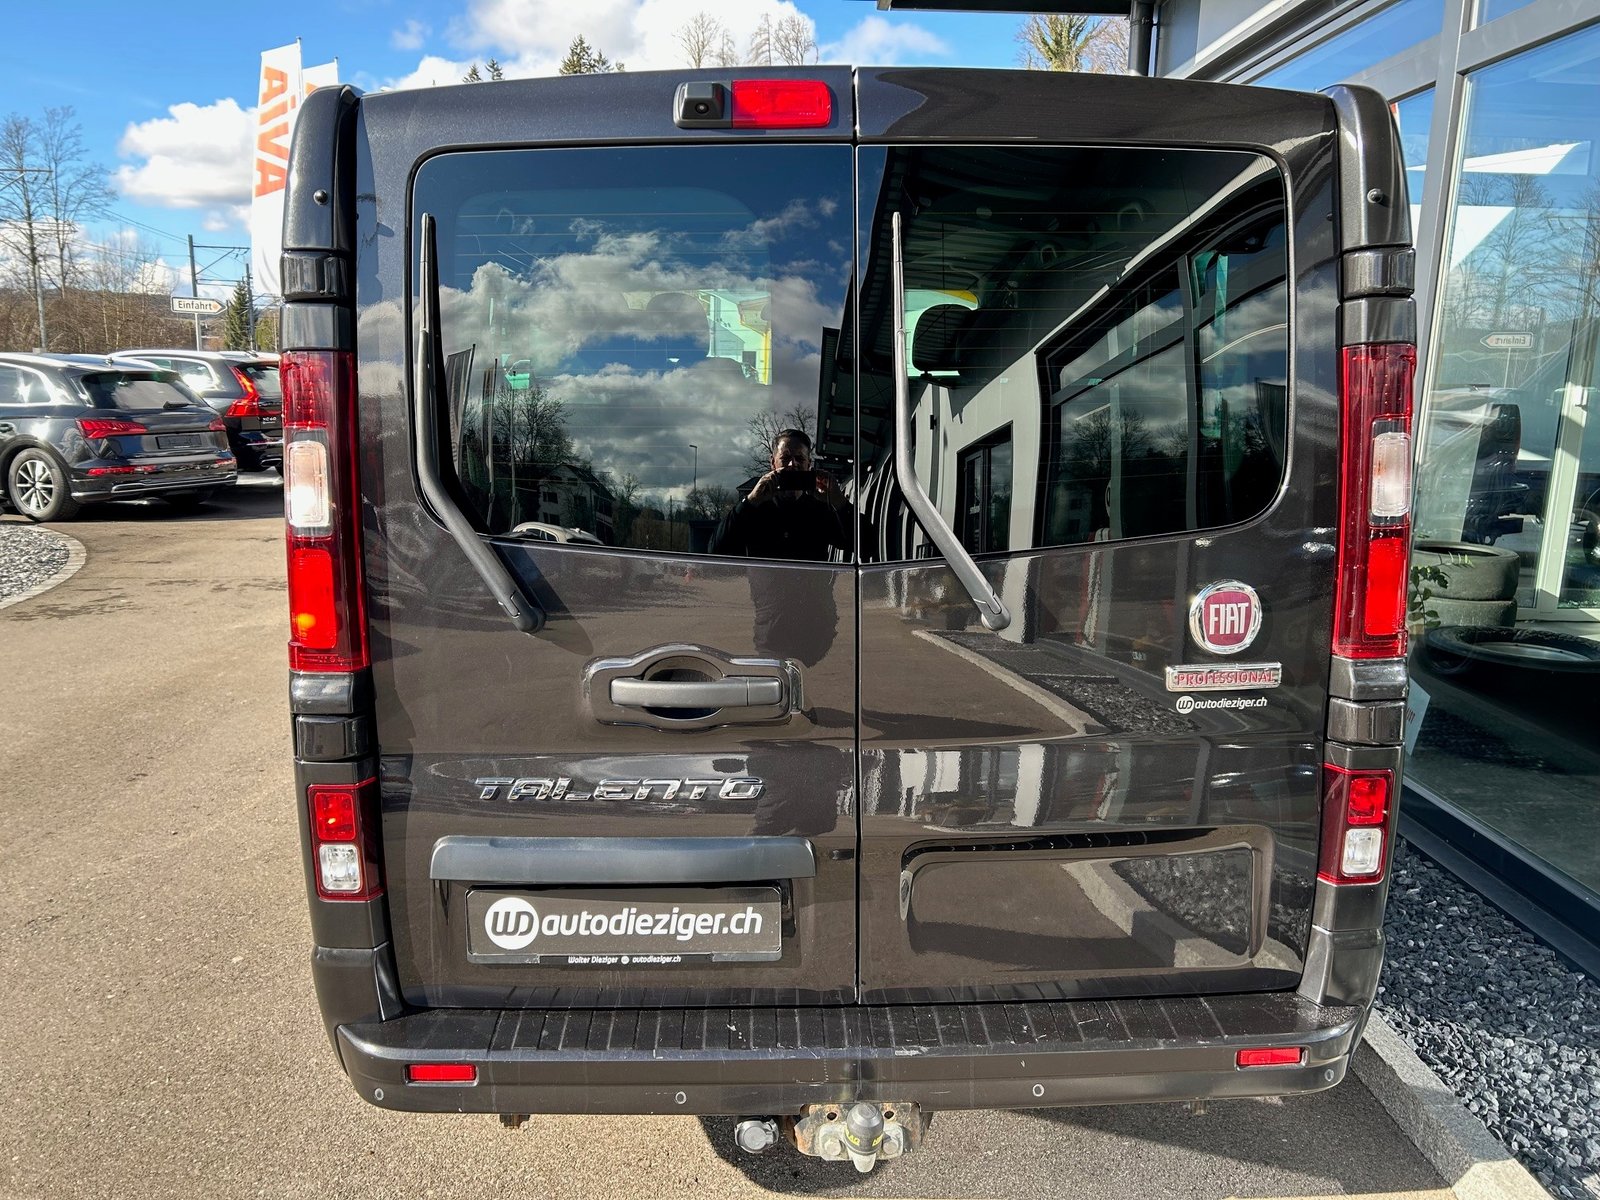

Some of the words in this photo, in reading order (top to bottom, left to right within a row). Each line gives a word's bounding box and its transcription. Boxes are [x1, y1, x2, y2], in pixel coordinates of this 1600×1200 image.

[178, 300, 212, 310] Einfahrt
[1209, 602, 1249, 635] FIAT
[1176, 670, 1275, 686] PROFESSIONAL
[1194, 696, 1268, 710] autodieziger.ch
[475, 777, 765, 800] TALENTO
[541, 906, 763, 941] autodieziger.ch
[591, 955, 619, 965] Dieziger
[632, 955, 682, 965] autodieziger.ch
